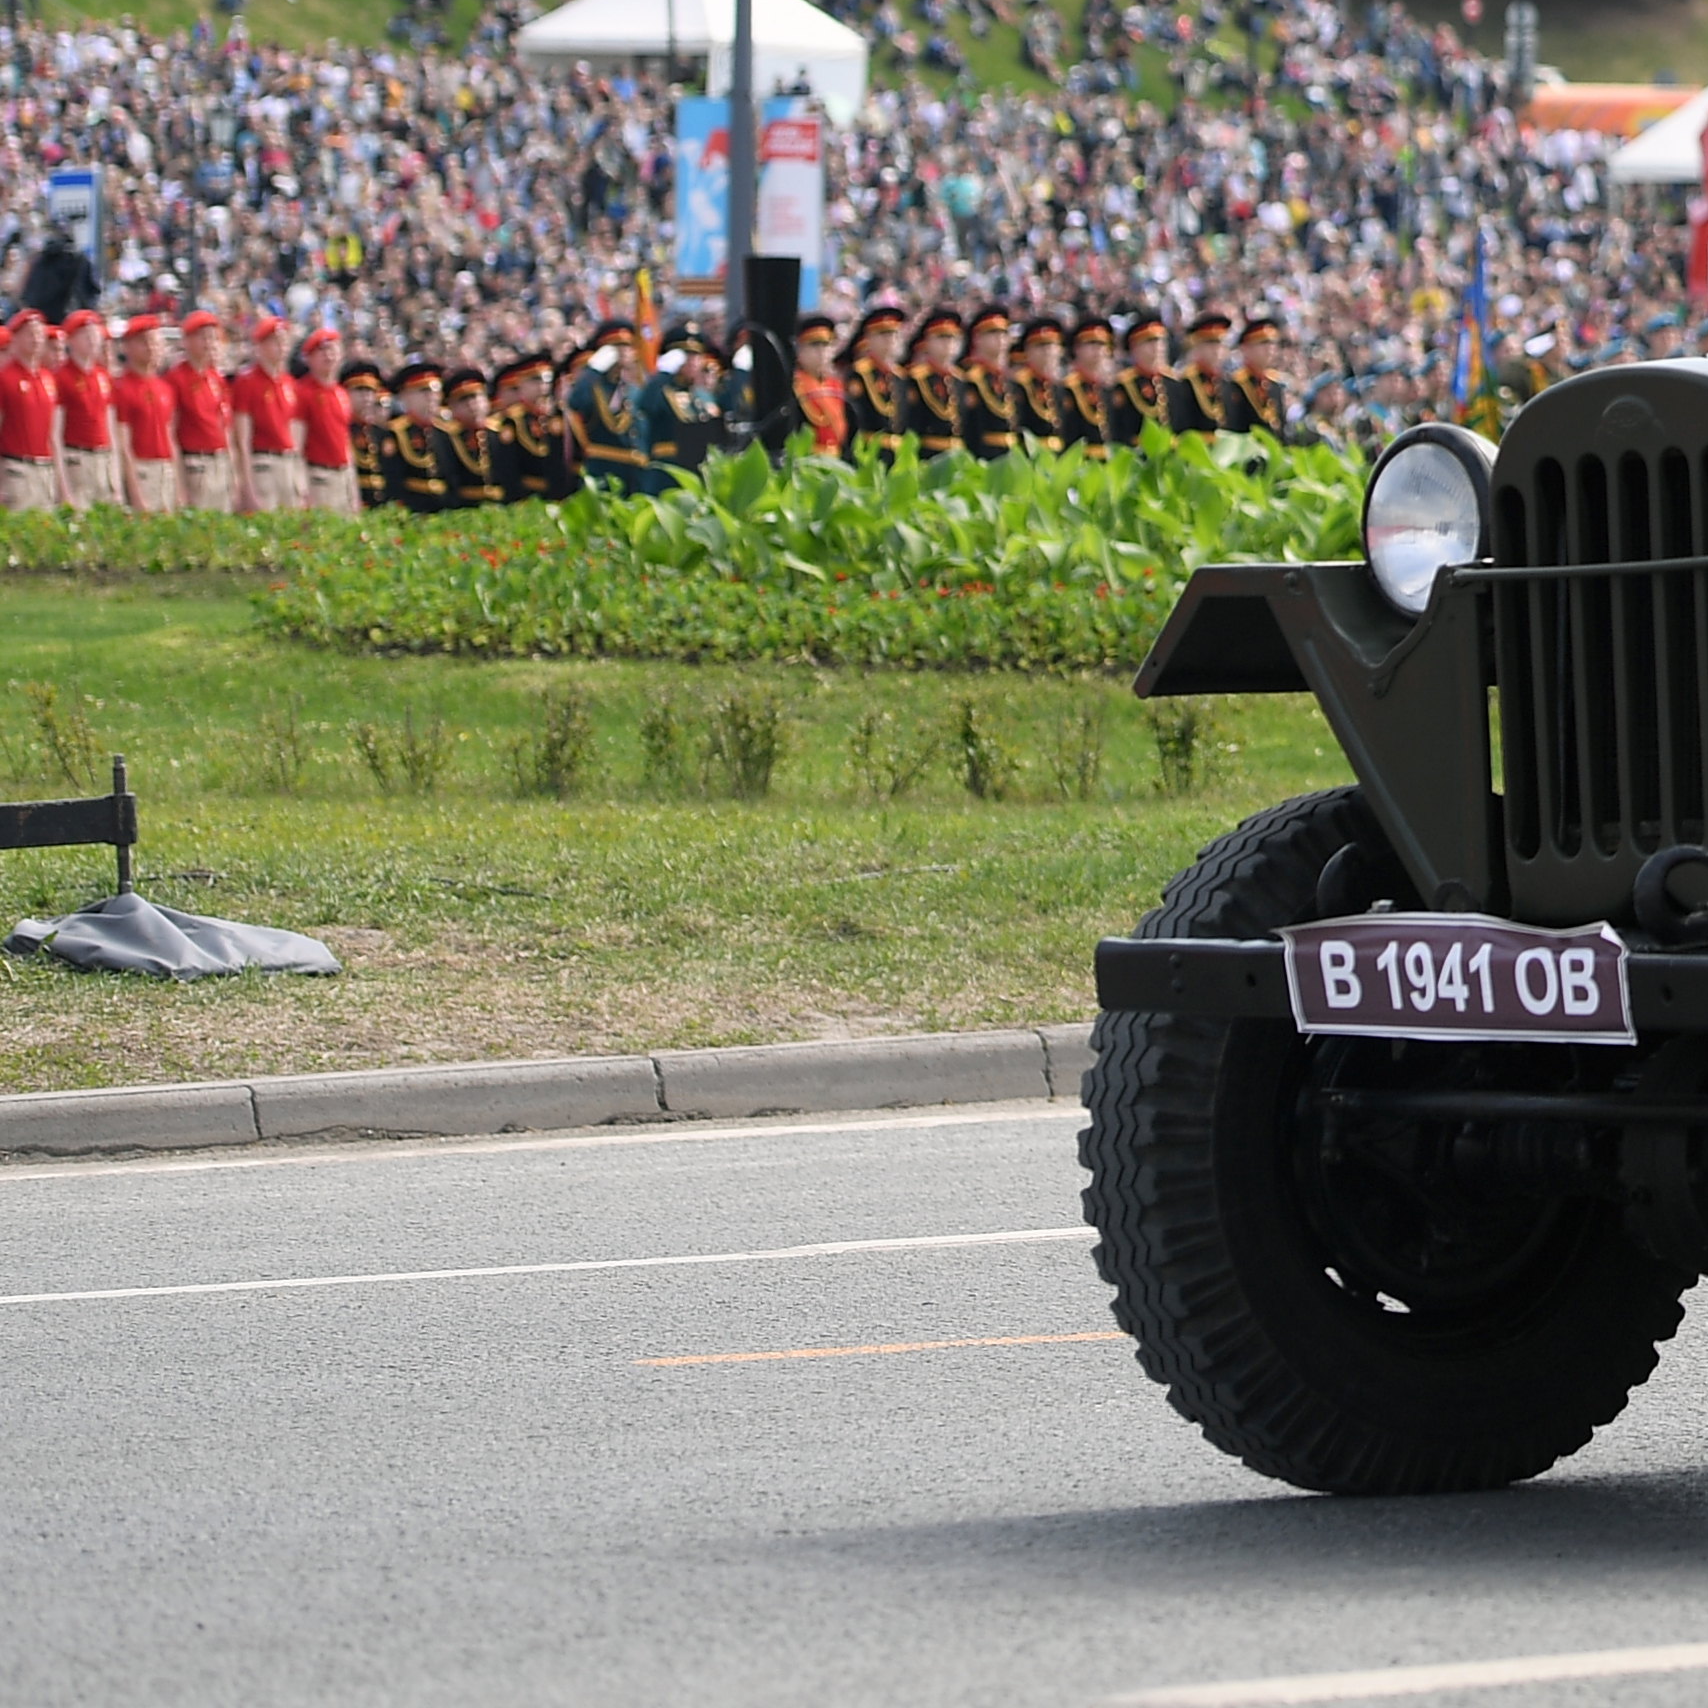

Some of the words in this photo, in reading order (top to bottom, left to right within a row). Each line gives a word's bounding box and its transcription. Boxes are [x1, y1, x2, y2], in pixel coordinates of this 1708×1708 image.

[1320, 940, 1362, 1008] В
[1377, 940, 1495, 1012] 1941
[1514, 947, 1600, 1016] ОВ
